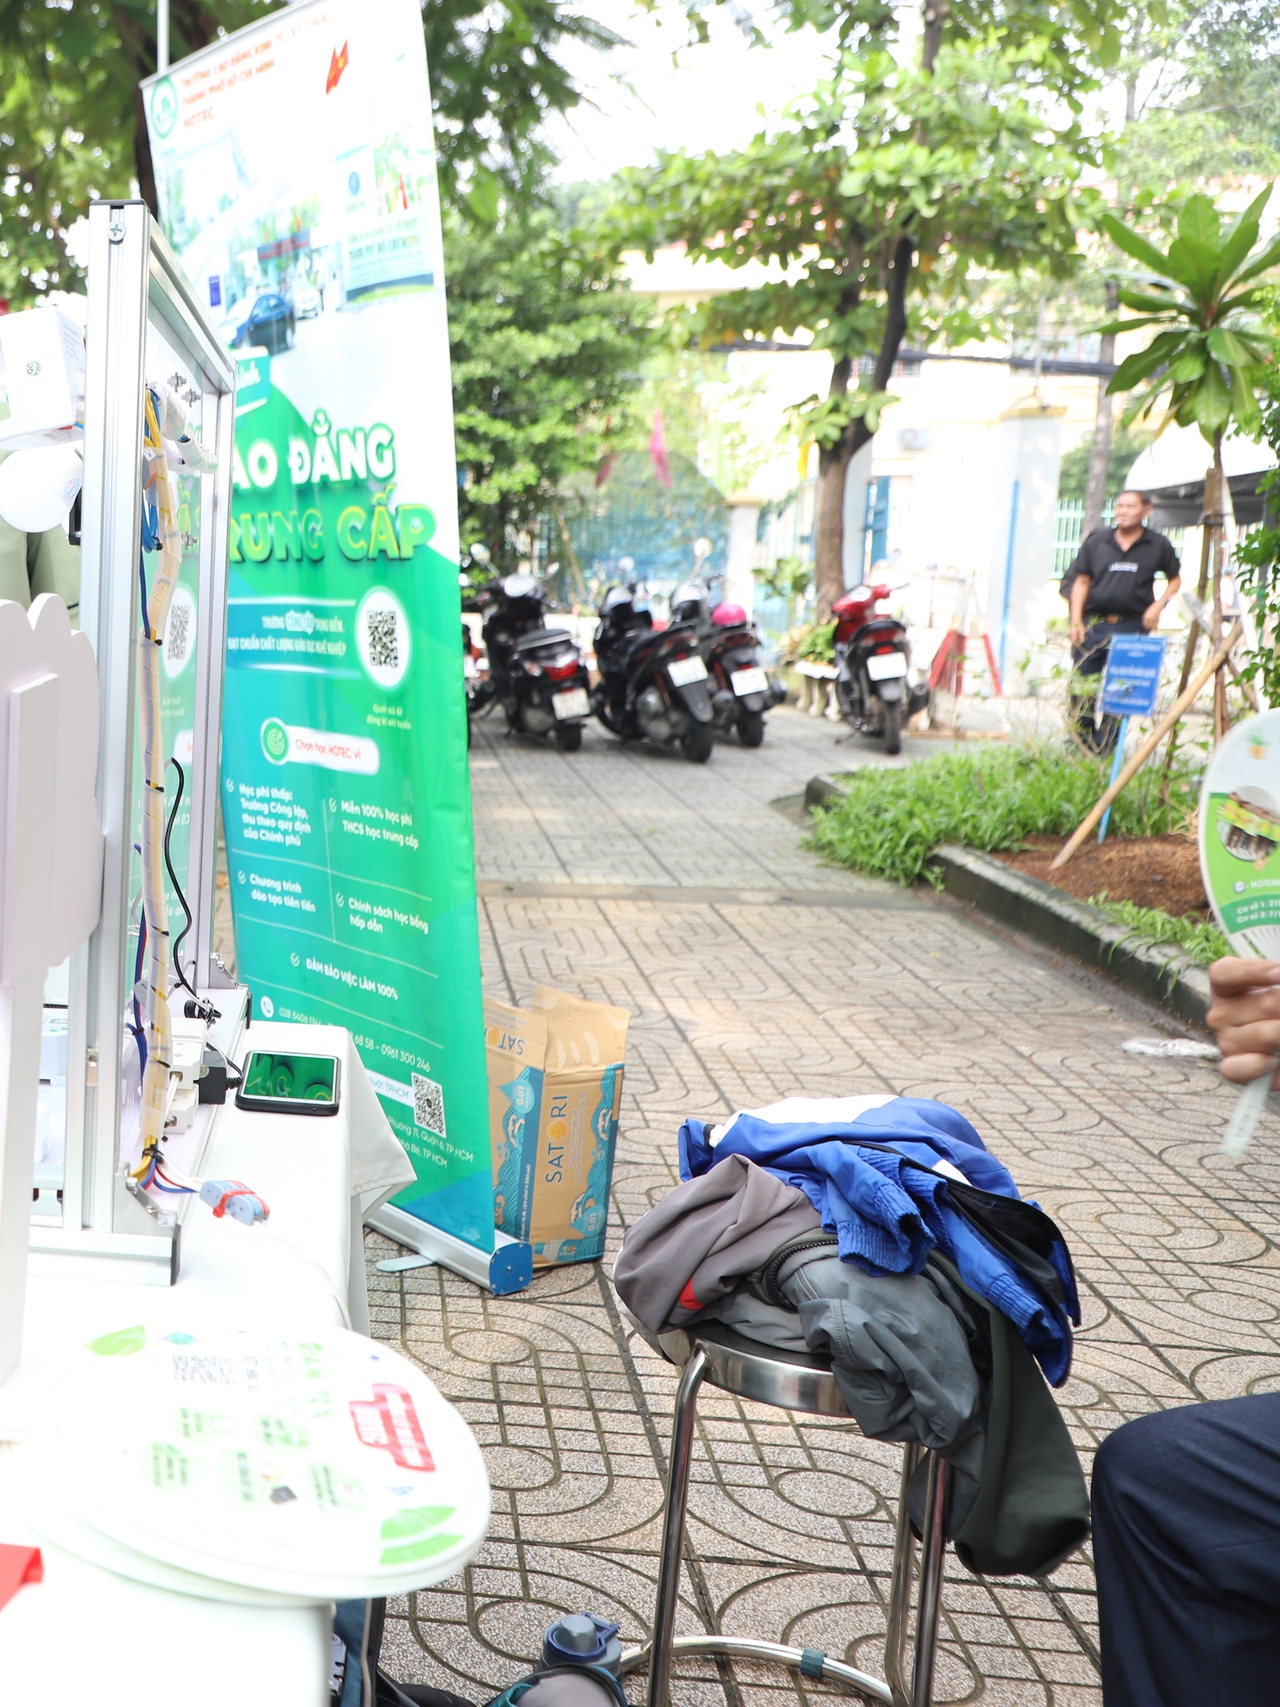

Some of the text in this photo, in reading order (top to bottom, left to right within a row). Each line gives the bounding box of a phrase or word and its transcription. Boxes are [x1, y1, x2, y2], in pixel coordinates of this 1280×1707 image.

[232, 408, 394, 489] AO ĐẲNG
[229, 508, 325, 563] RUNG
[336, 483, 437, 561] CẤP
[295, 738, 362, 760] Chọn học HOTEC vì
[238, 783, 255, 799] Học
[255, 784, 270, 800] phí
[240, 798, 269, 815] Trường
[270, 802, 293, 819] Công
[341, 800, 413, 827] Miễn 100% học phí
[242, 813, 312, 835] thu theo quy định
[342, 820, 420, 851] THCS học trung cấp
[243, 827, 302, 848] của Chính phủ
[249, 873, 302, 894] Chương trình
[1250, 878, 1280, 889] HOTLIN
[251, 888, 316, 913] đào tạo tiên tiến
[348, 896, 373, 915] Chính
[373, 903, 393, 920] sách
[393, 908, 409, 926] học
[349, 913, 366, 931] hấp
[306, 957, 399, 1001] ĐẢM BẢO VIỆC LÀM 100%
[278, 1007, 292, 1019] 028
[355, 1034, 364, 1046] 68
[364, 1037, 375, 1050] 58
[381, 1044, 399, 1059] 0961
[400, 1050, 416, 1066] 300
[416, 1057, 431, 1073] 246
[484, 1028, 525, 1056] SATO
[384, 1082, 409, 1099] TPHCM
[421, 1131, 439, 1148] Quận
[445, 1143, 455, 1154] TP
[454, 1148, 474, 1163] HCM
[545, 1095, 568, 1183] SATORI
[422, 1149, 431, 1159] TP
[431, 1152, 448, 1168] HCM
[587, 1212, 598, 1231] 0.01
